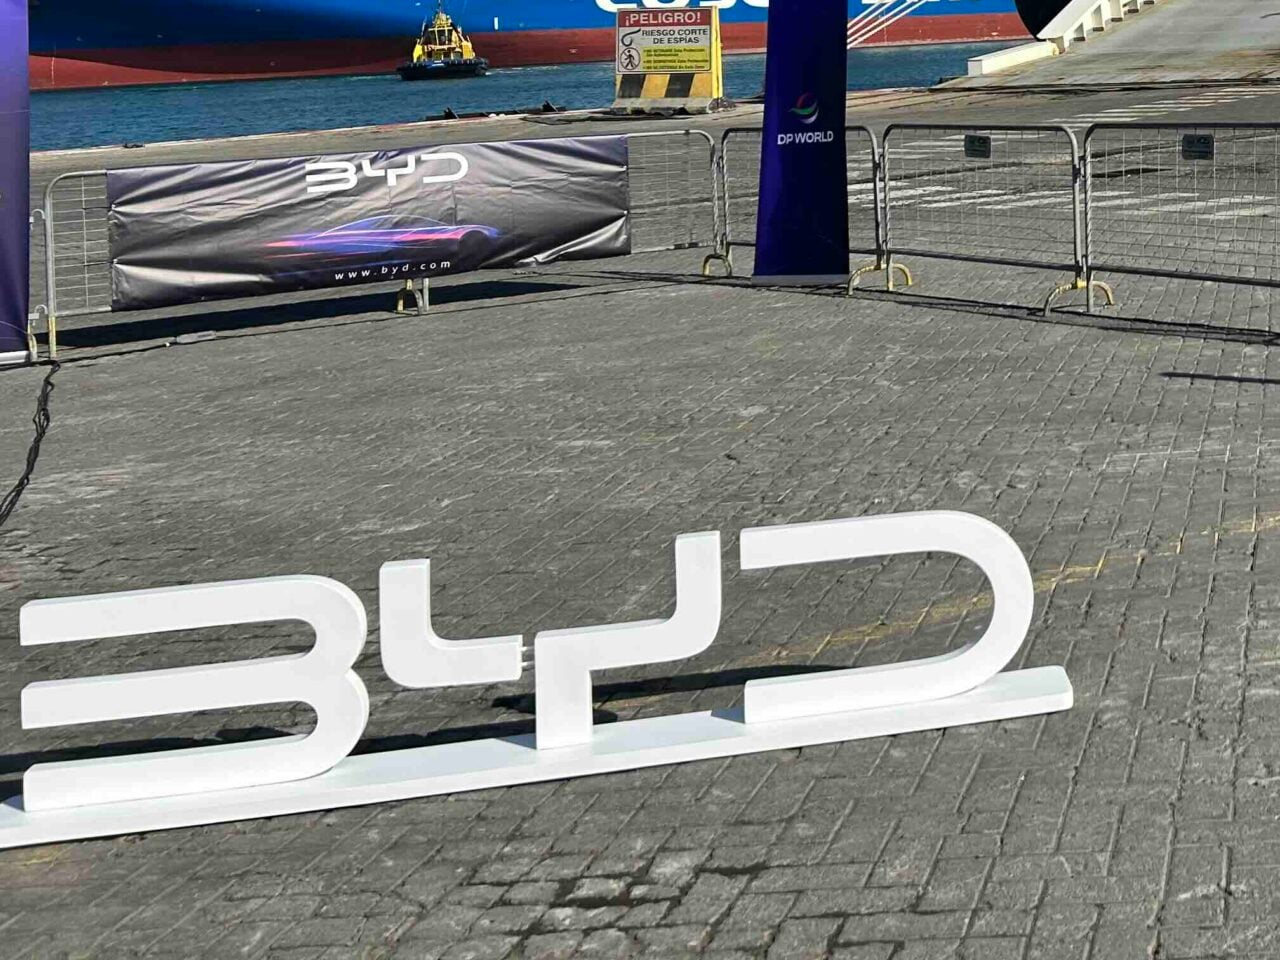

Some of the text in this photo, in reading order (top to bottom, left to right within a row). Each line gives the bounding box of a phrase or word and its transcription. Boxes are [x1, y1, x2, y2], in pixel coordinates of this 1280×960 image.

[625, 12, 701, 26] ¡PELIGRO!
[641, 28, 708, 37] RIESGO CORTE
[667, 36, 700, 44] ESPÍAS
[777, 130, 834, 146] DP WORLD
[305, 151, 468, 194] BYD
[334, 260, 451, 281] www.byd.com
[19, 509, 1035, 814] BYD
